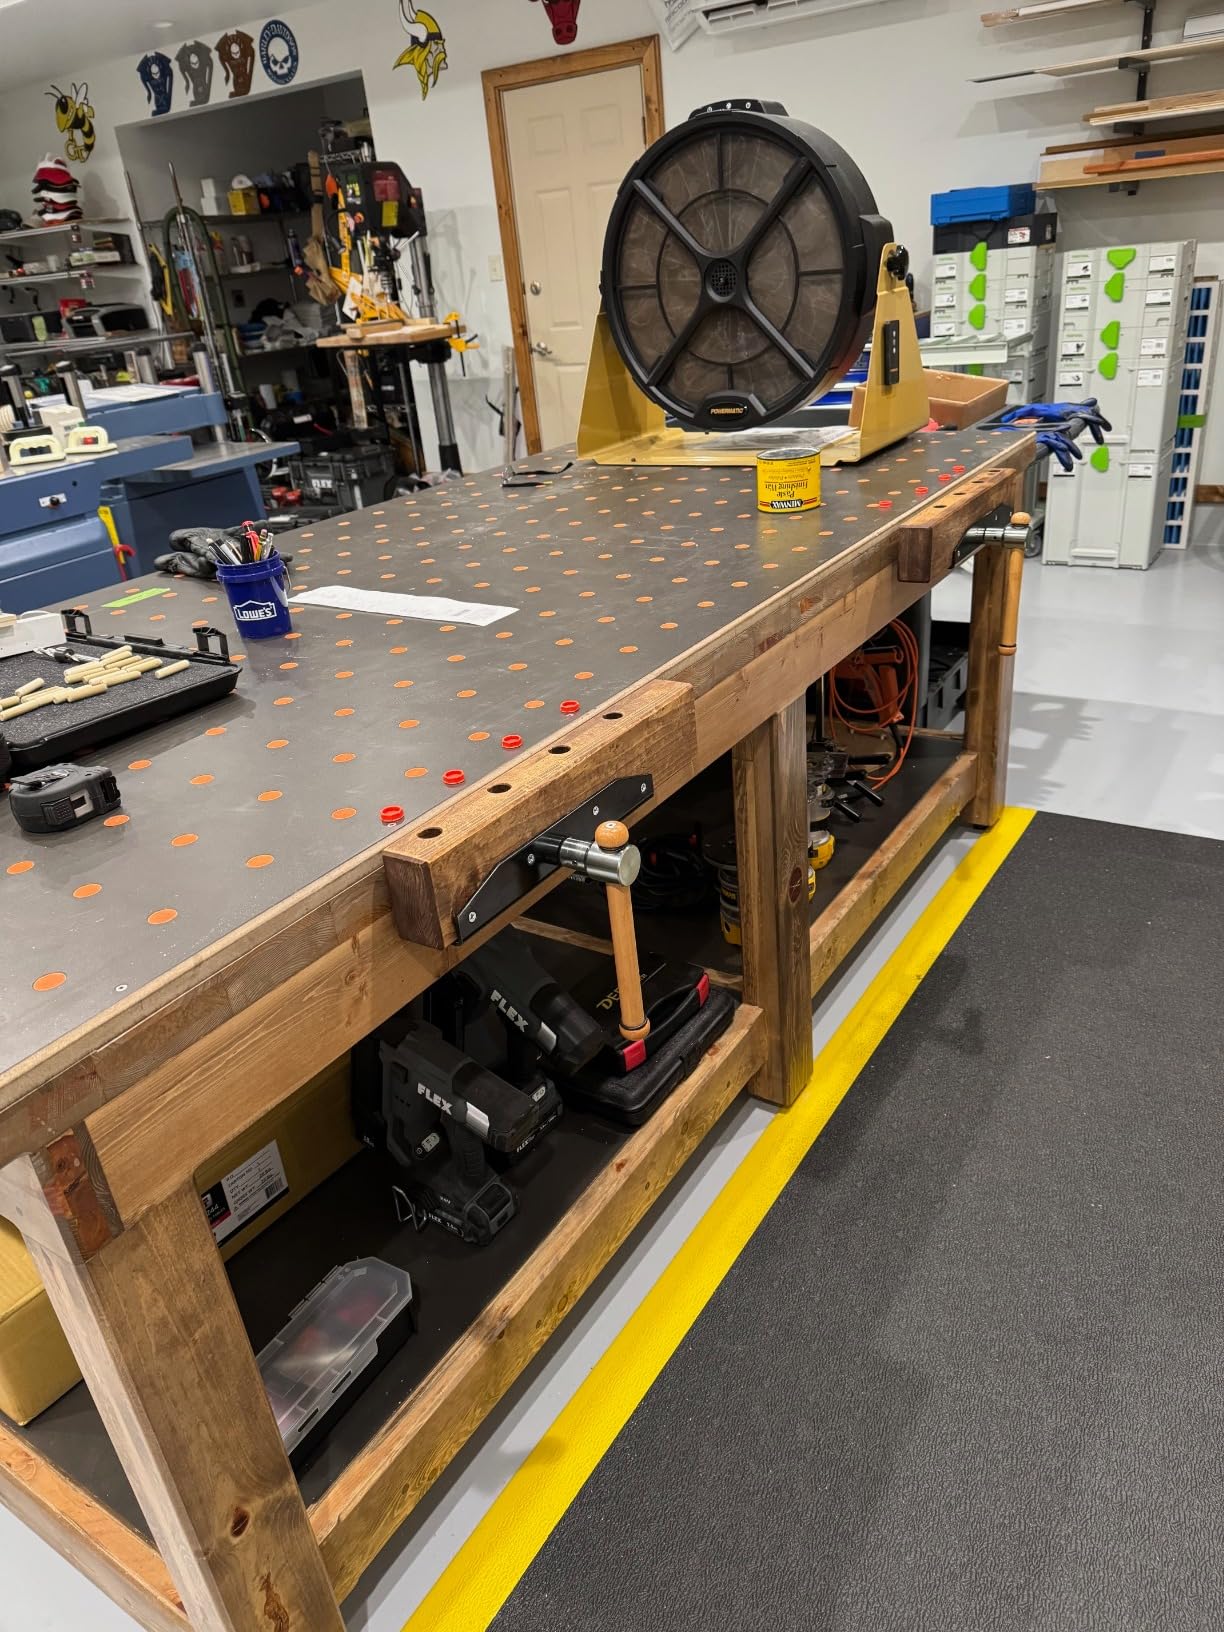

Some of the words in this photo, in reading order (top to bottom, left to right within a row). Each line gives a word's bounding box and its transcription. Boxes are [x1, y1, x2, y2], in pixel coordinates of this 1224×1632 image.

[710, 407, 744, 415] POWERMATIC
[778, 481, 808, 491] Finishing
[772, 500, 801, 509] MINWAX
[490, 989, 529, 1033] FLEX
[417, 1082, 453, 1116] FLEX
